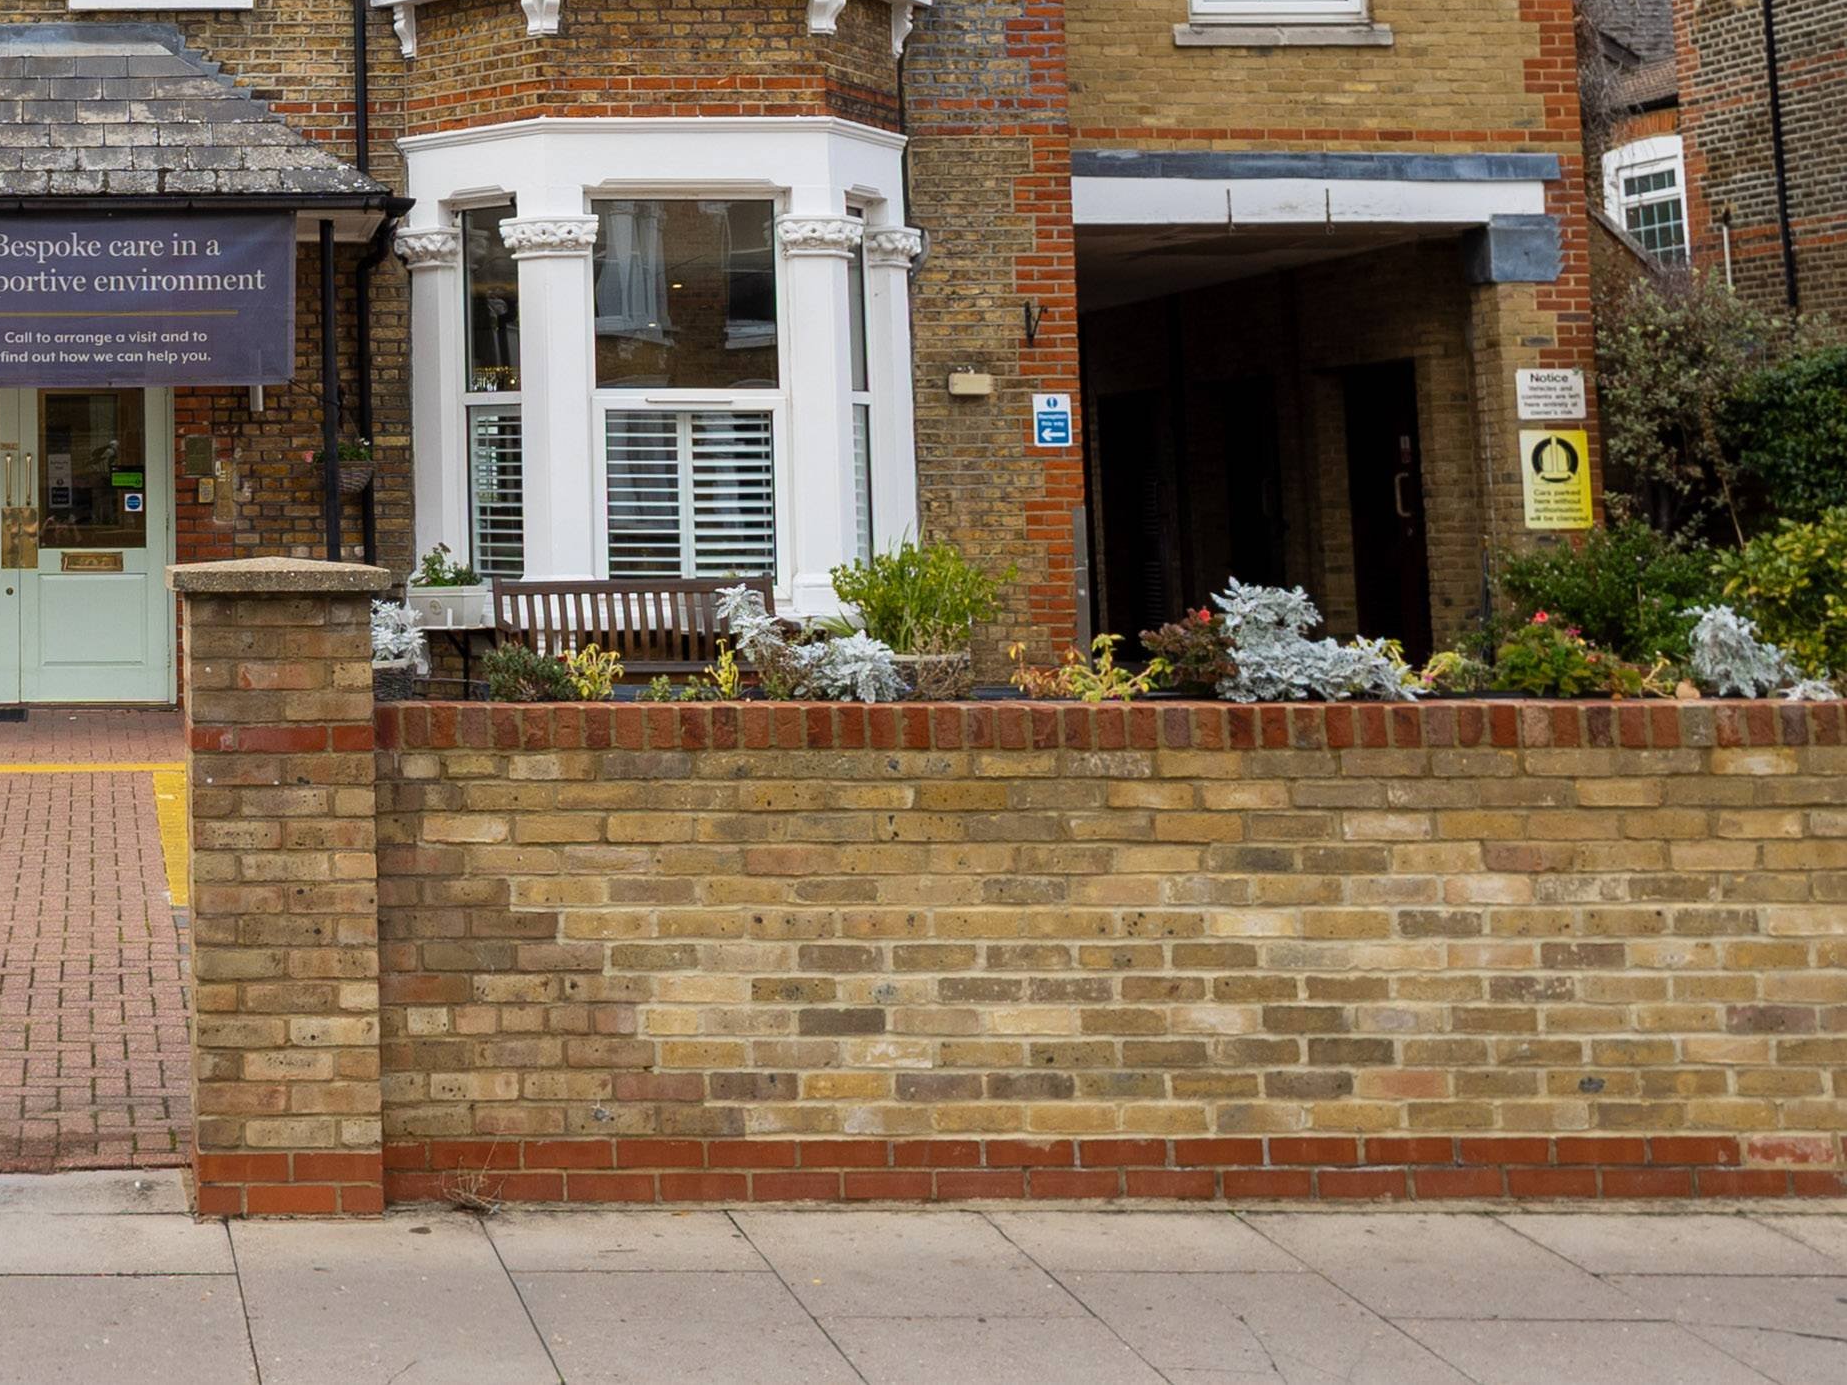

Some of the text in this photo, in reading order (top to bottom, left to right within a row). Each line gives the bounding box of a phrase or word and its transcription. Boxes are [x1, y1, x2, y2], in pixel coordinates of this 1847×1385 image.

[108, 237, 165, 257] care
[171, 232, 198, 256] in
[206, 238, 221, 256] a
[94, 267, 267, 292] environment
[4, 330, 208, 346] Call to arrange a visit and to
[0, 348, 212, 365] find out how we can help you.
[1530, 373, 1569, 383] Notice
